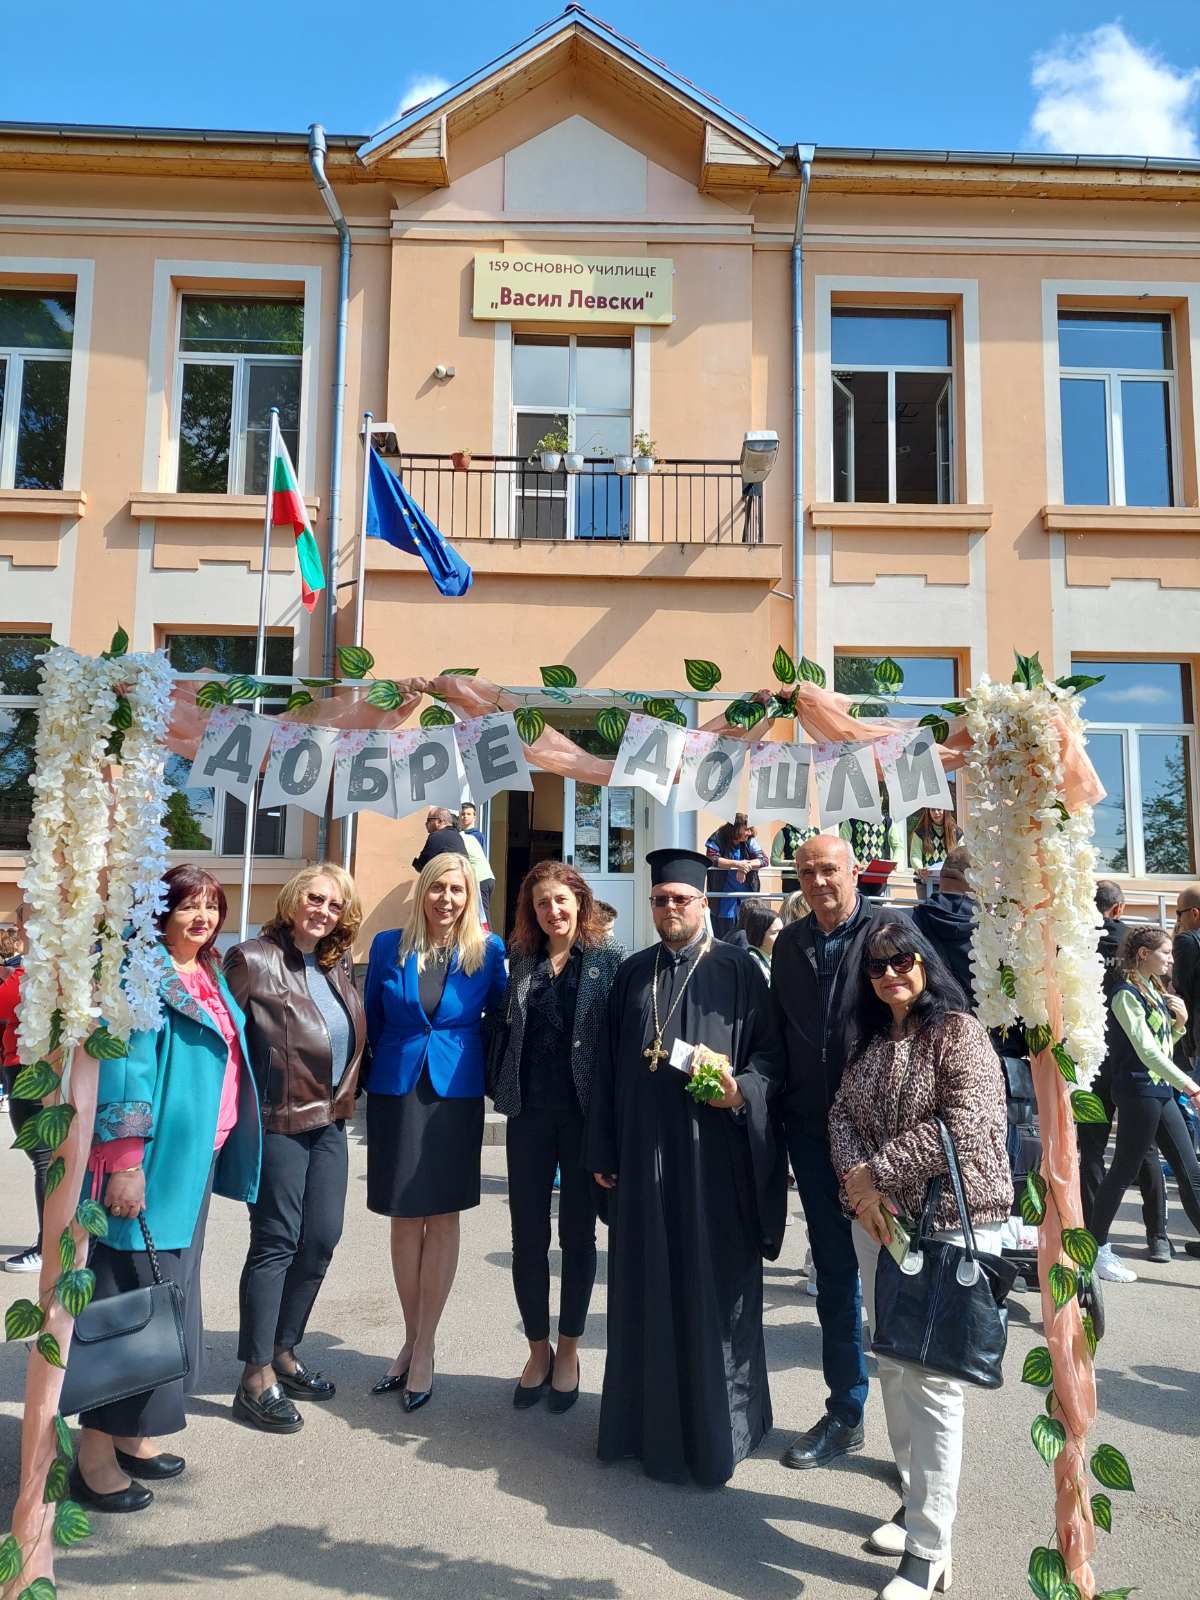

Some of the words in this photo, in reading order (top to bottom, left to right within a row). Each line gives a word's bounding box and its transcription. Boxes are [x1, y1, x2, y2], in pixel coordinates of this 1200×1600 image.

[489, 260, 509, 272] 159
[513, 261, 584, 275] ОСНОВНО
[588, 264, 657, 278] УЧИЛИЩЕ
[490, 286, 562, 310] „Васил
[203, 723, 519, 802] ДОБРЕ
[624, 728, 940, 812] ДОШЛИ
